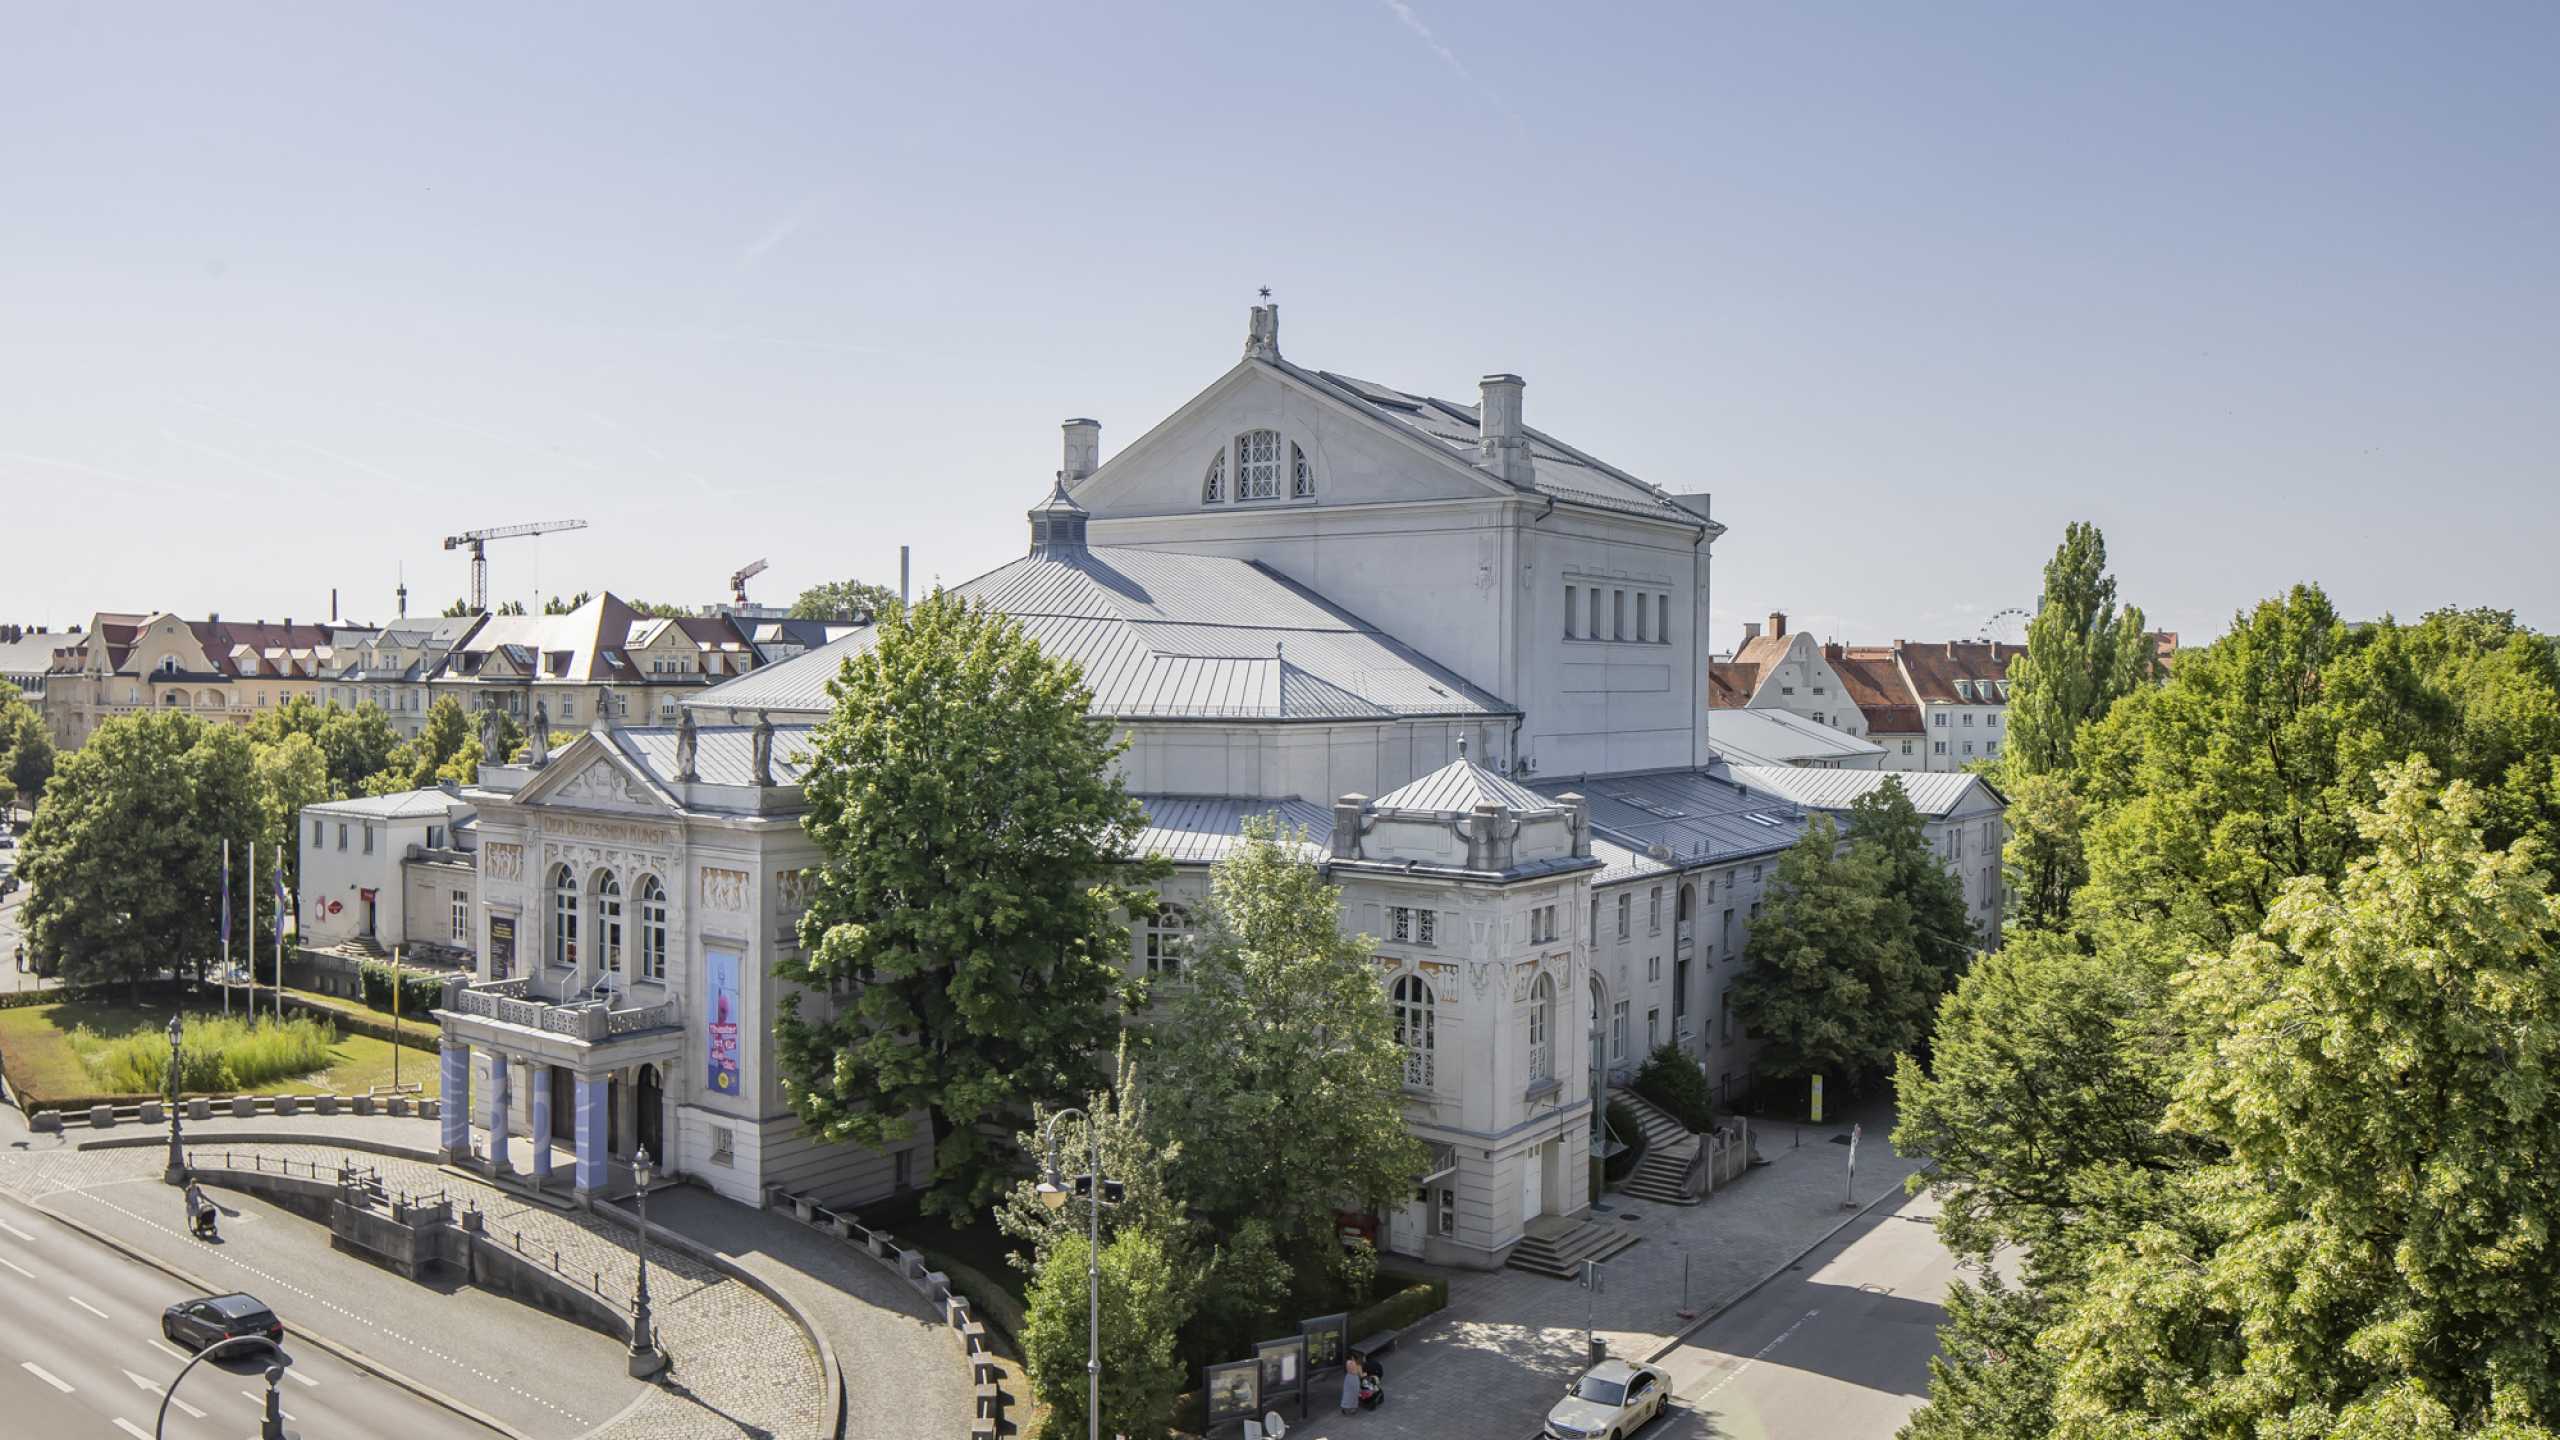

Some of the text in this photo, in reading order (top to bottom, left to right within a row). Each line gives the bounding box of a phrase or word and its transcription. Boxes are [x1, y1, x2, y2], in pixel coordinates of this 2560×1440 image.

[544, 815, 664, 846] DER DEUTSCHEN KUNST
